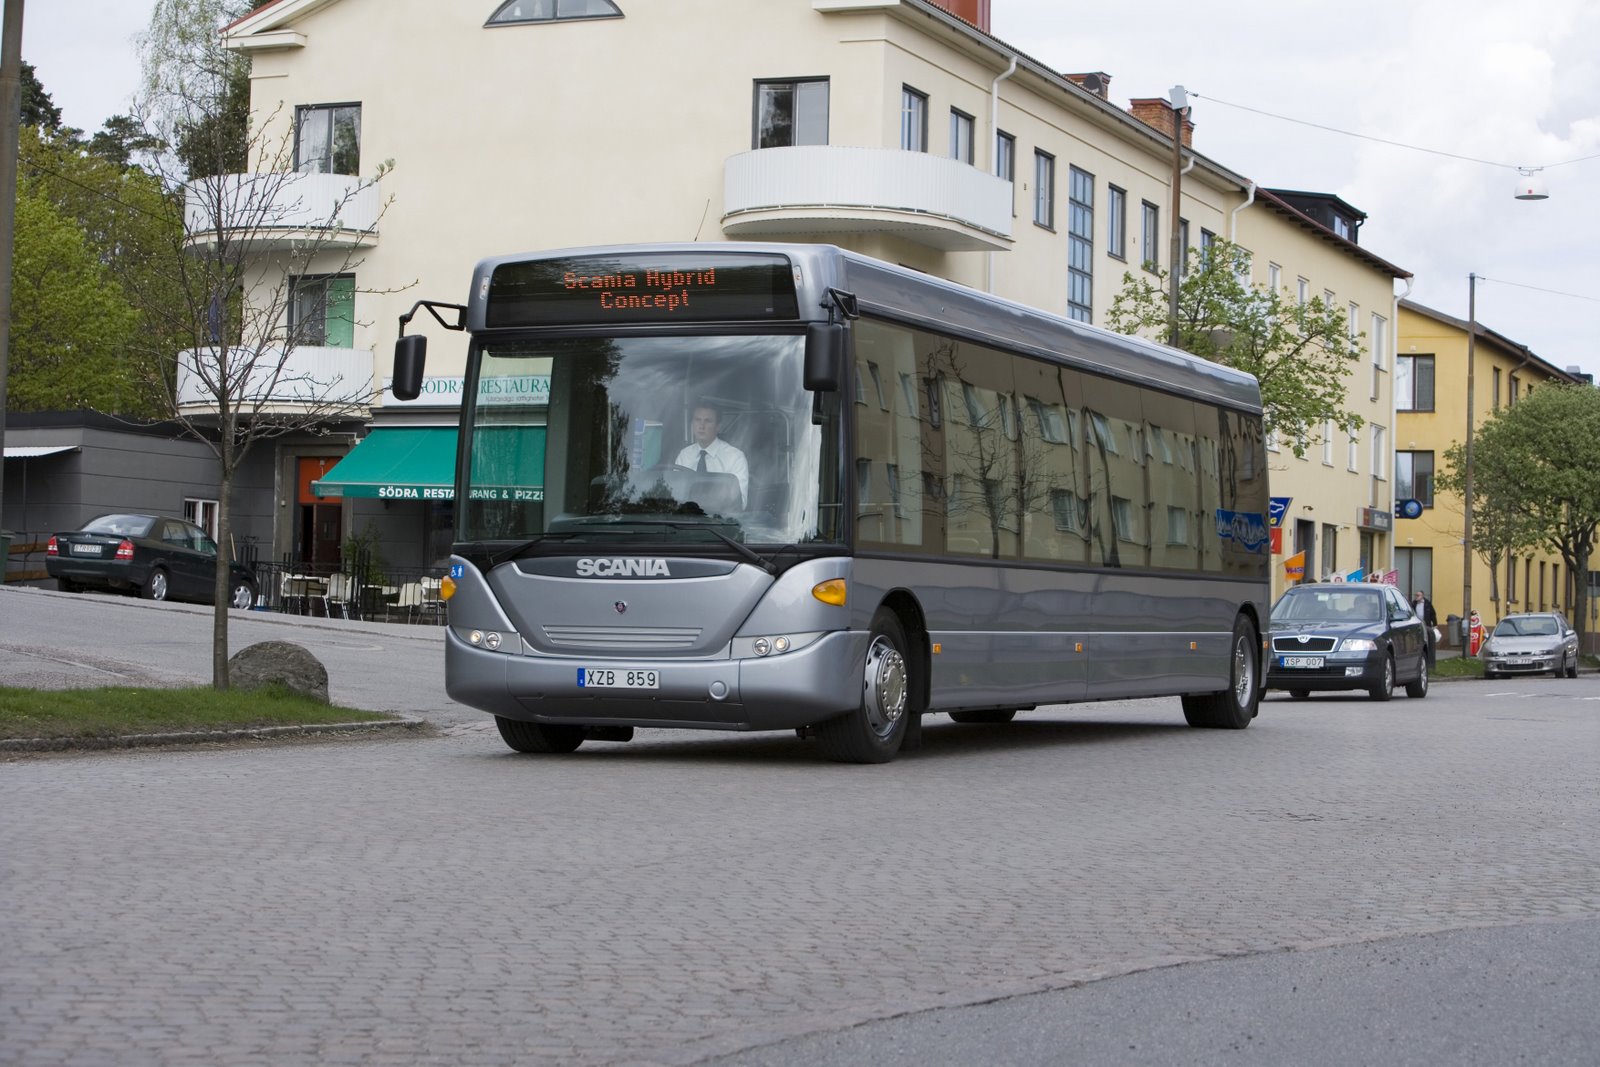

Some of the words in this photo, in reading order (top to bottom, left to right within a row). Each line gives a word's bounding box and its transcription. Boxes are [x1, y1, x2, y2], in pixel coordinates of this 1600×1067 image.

[564, 271, 636, 289] Scania
[646, 267, 716, 291] Hybrid
[601, 289, 689, 311] Concept
[378, 485, 418, 498] SÖDRA
[502, 490, 509, 499] &
[576, 558, 671, 576] SCANIA
[1285, 658, 1300, 666] XSP
[1306, 658, 1322, 666] 007
[587, 670, 615, 686] XZB
[627, 671, 656, 687] 859
